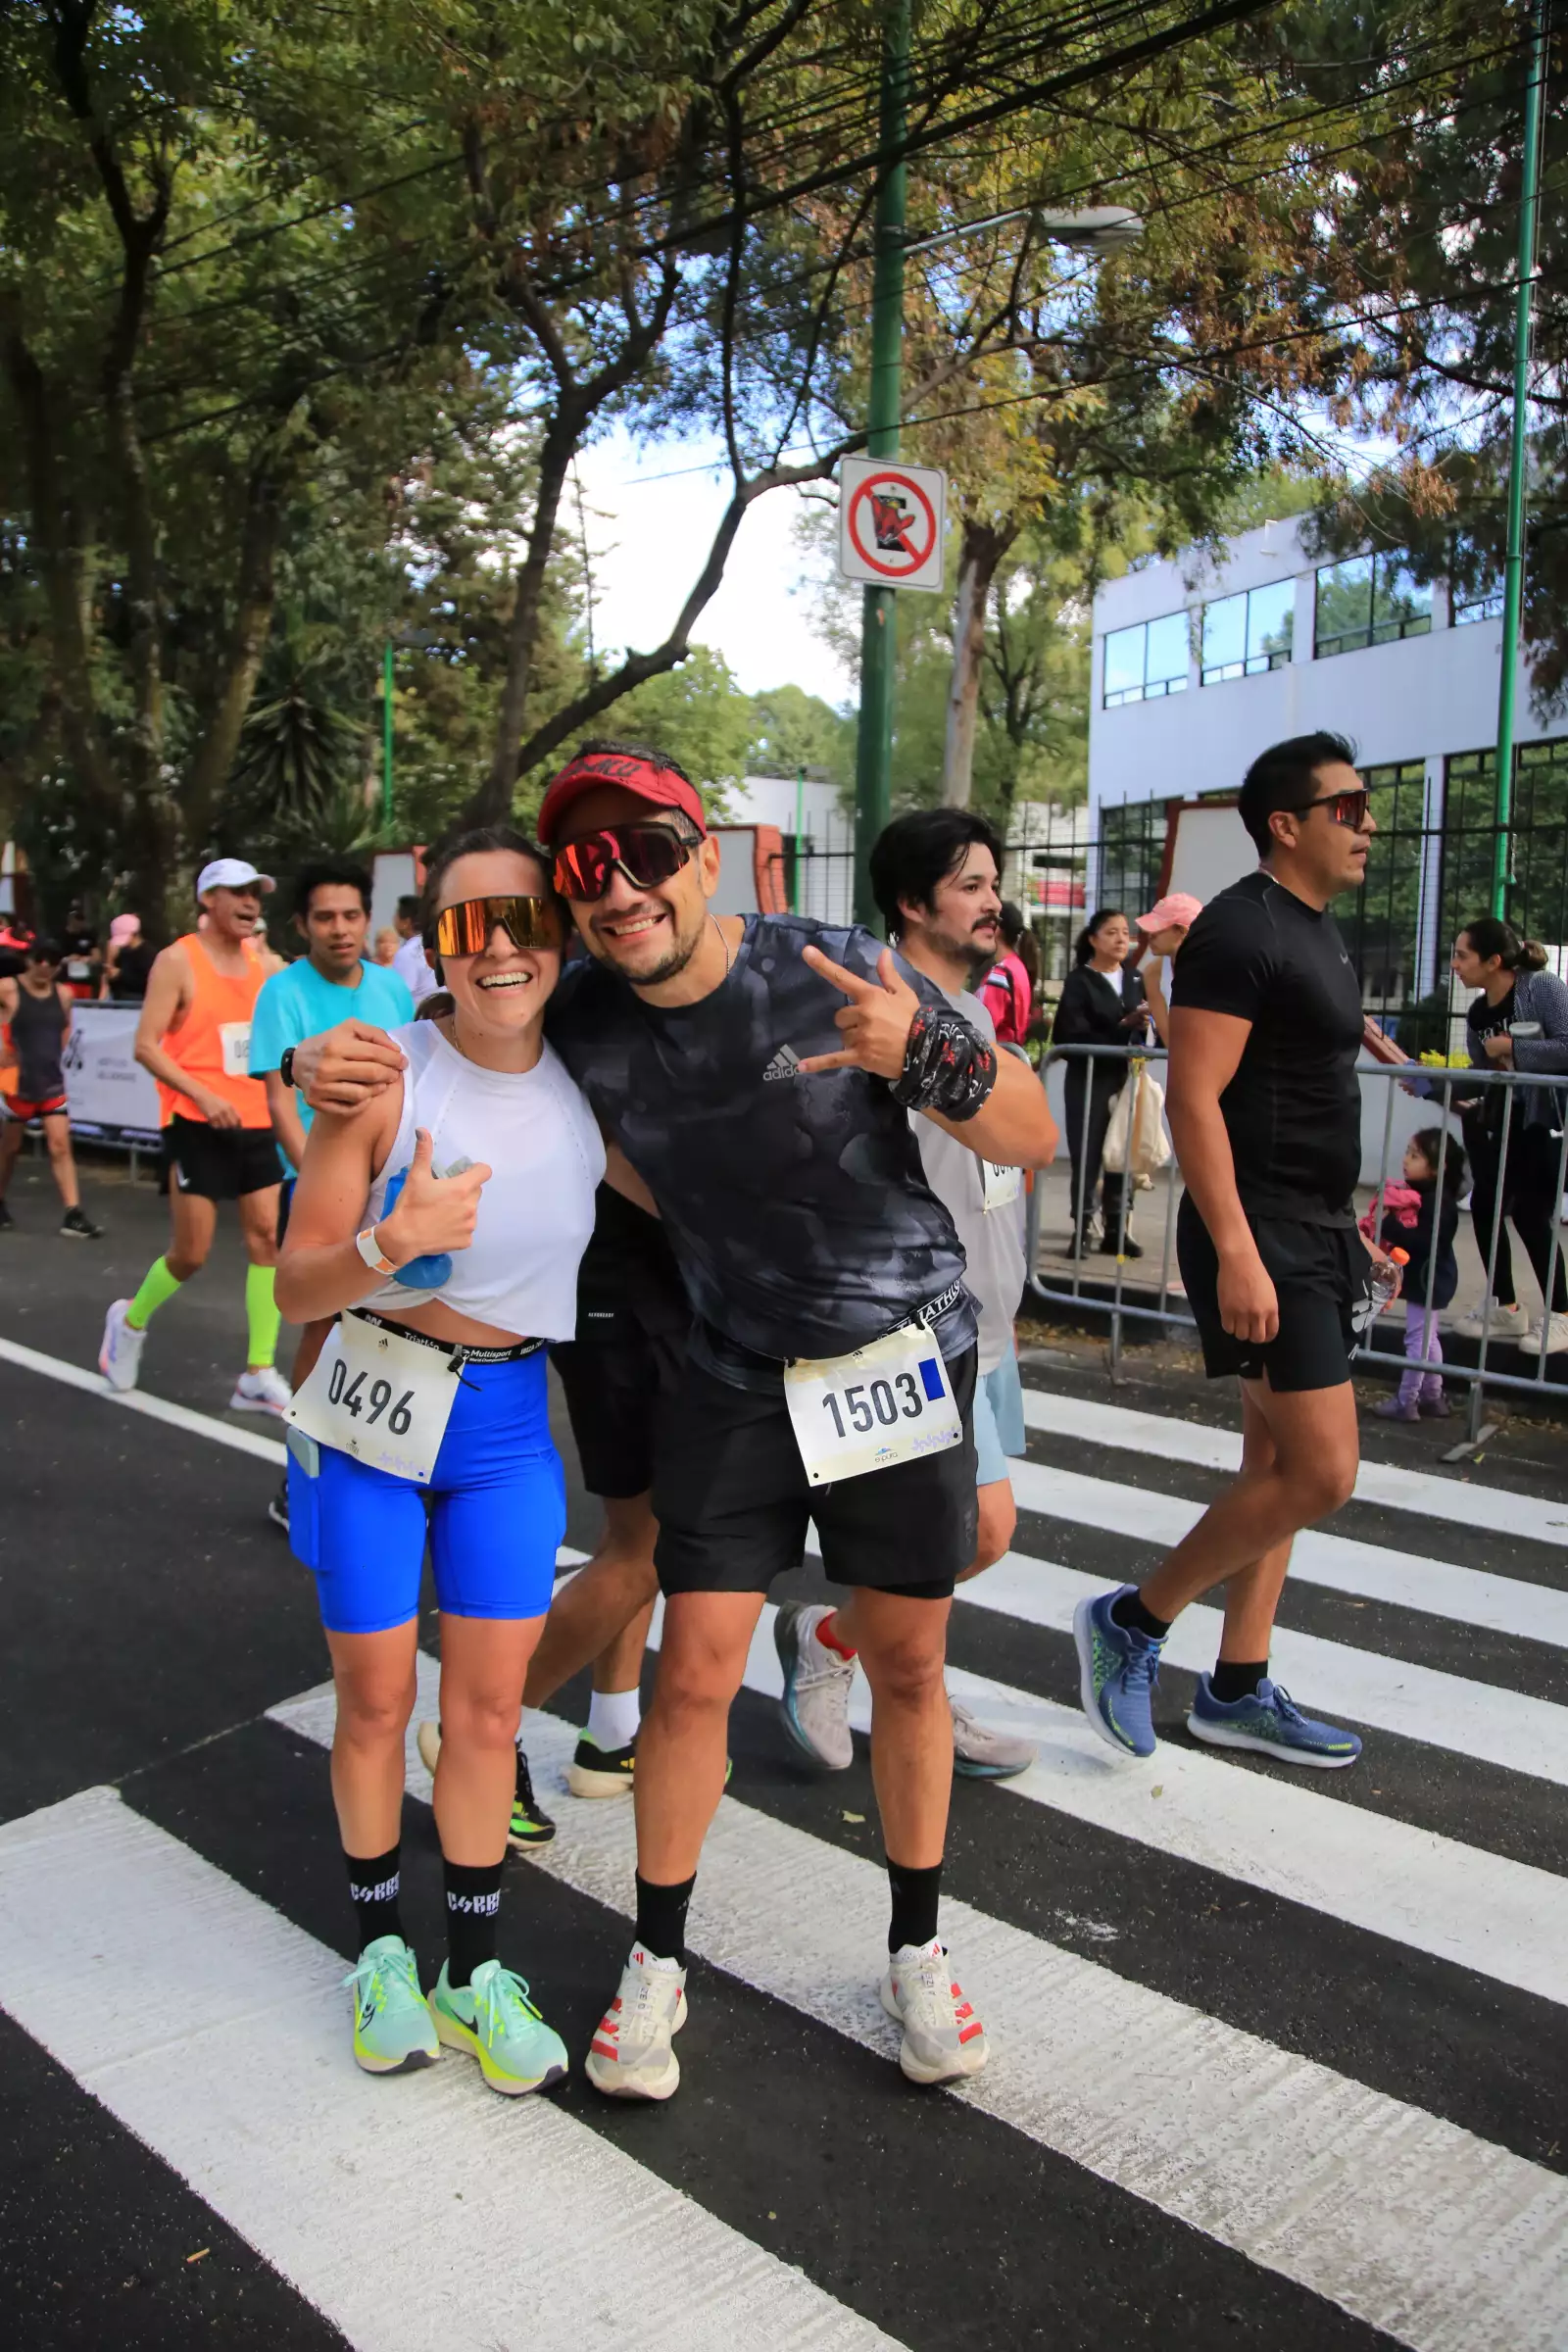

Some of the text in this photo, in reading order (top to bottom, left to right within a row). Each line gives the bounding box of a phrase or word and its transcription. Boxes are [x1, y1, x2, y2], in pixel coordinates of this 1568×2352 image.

[470, 1349, 513, 1359] Multisport
[328, 1358, 416, 1436] 0496
[822, 1372, 923, 1439] 1503
